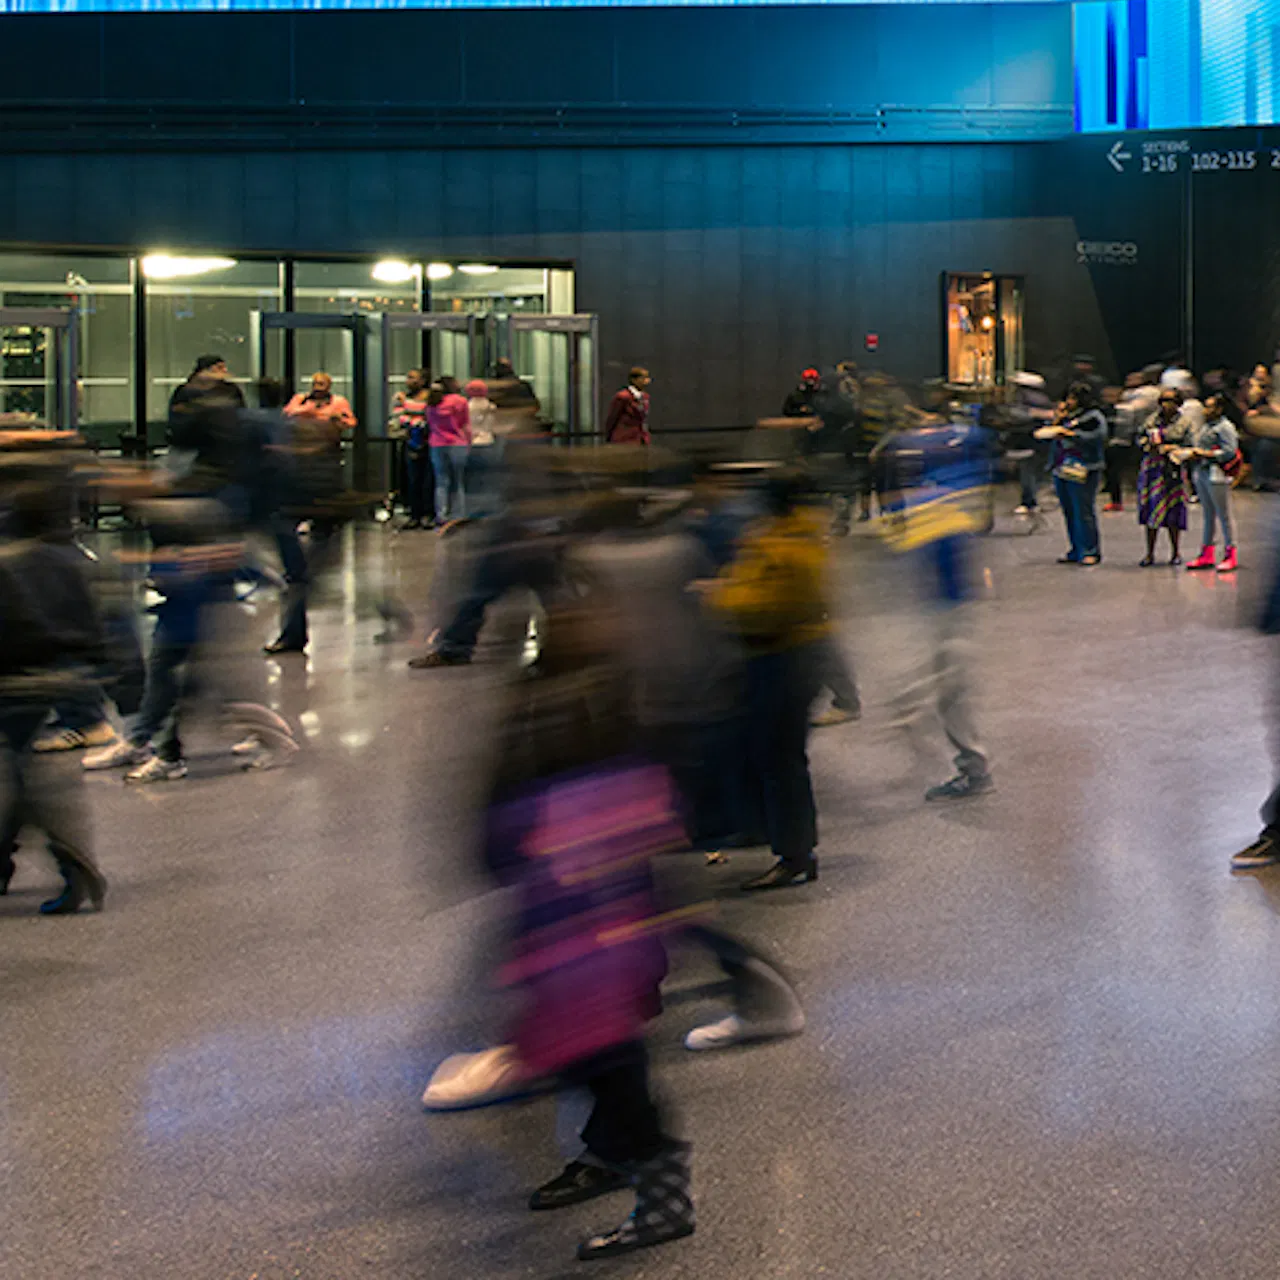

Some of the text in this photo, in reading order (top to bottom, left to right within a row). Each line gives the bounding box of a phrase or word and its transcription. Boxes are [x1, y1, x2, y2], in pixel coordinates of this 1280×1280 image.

[1142, 140, 1190, 153] SECTIONS
[1142, 154, 1178, 172] 1-16
[1191, 151, 1257, 170] 102-115
